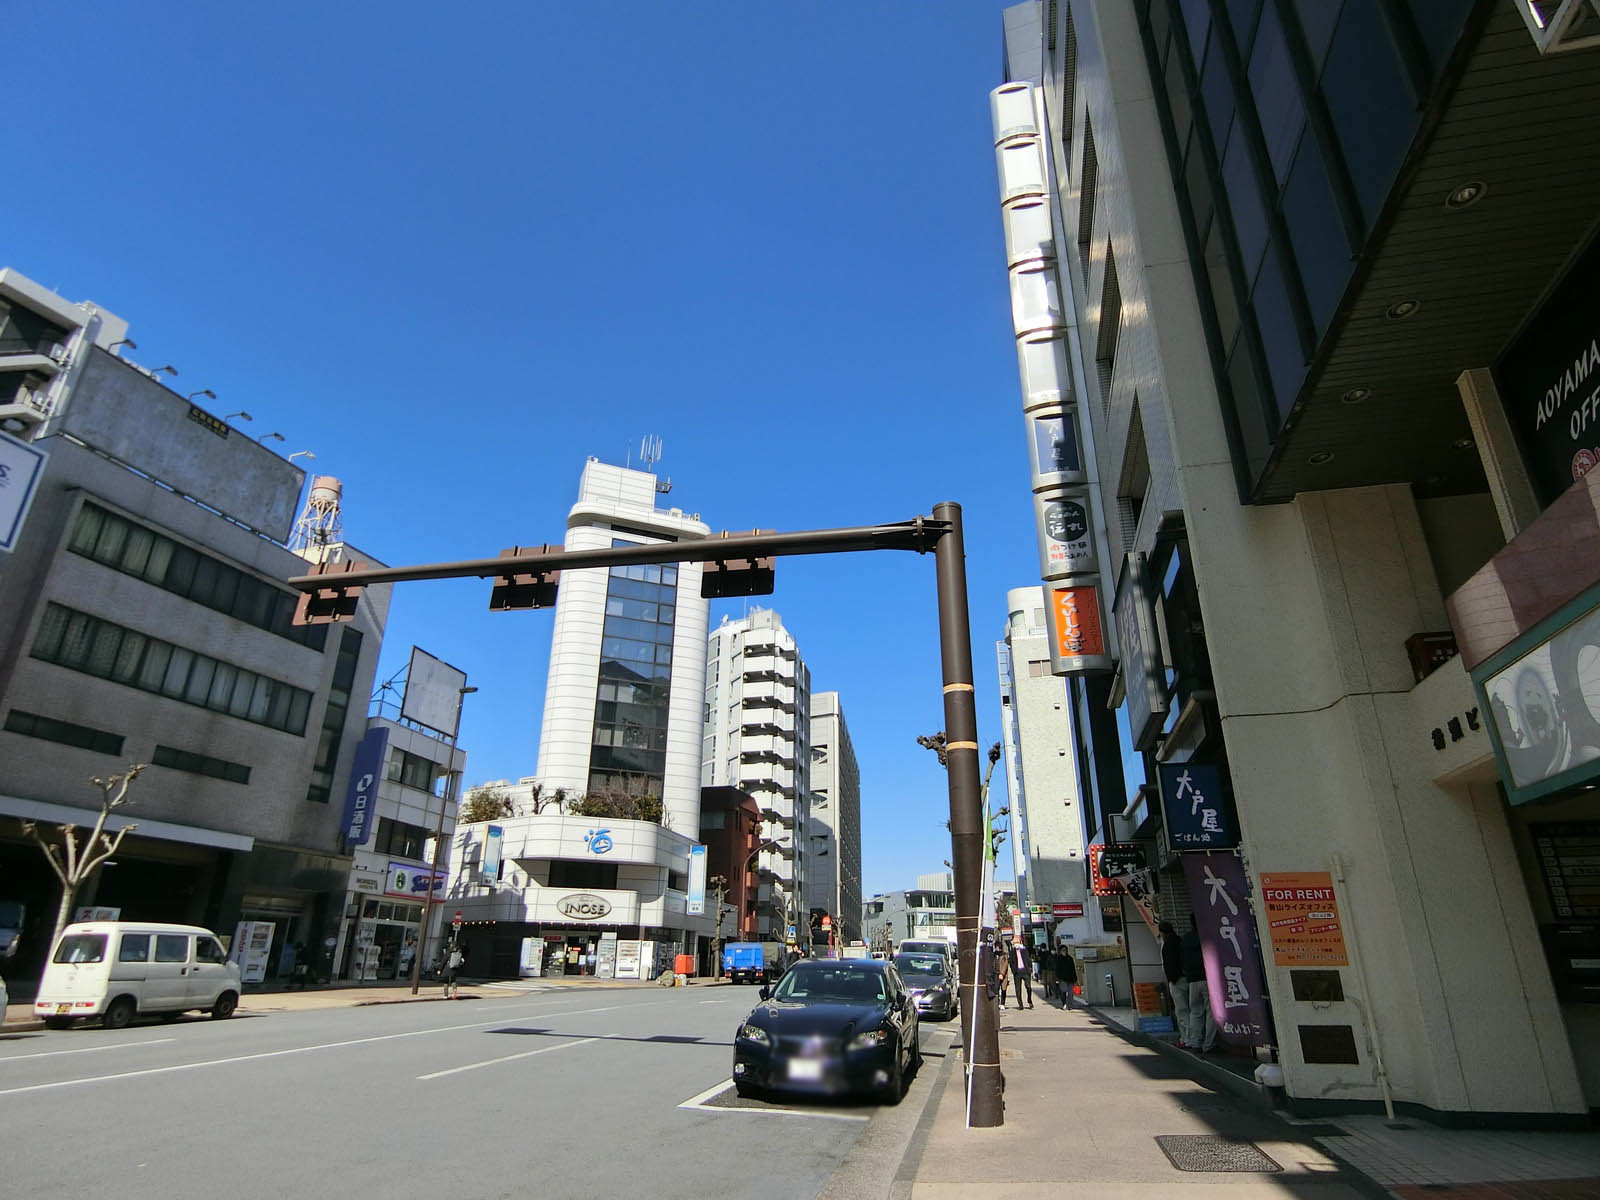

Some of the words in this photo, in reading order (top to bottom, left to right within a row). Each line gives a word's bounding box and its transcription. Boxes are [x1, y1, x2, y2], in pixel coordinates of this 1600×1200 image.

[1536, 339, 1600, 431] AOYAMA
[1176, 769, 1223, 832] 大戸屋
[564, 902, 605, 915] INOSE
[1266, 889, 1293, 900] FOR
[1296, 889, 1331, 900] RENT
